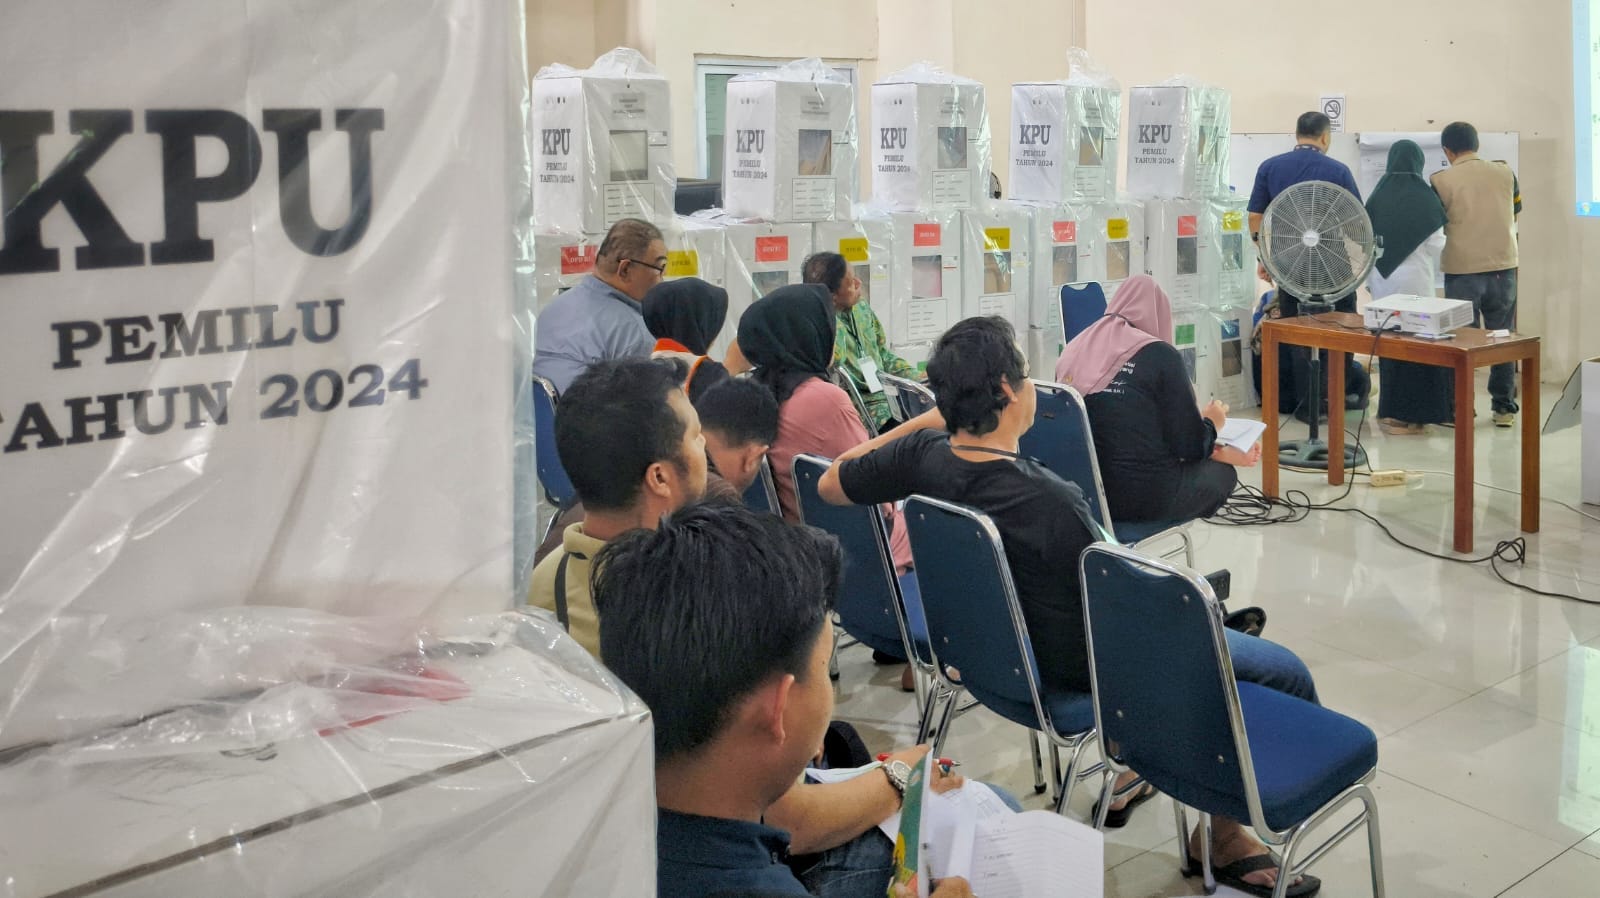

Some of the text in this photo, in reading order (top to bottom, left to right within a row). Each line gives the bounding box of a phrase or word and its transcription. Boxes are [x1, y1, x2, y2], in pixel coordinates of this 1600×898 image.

[541, 128, 571, 155] KPU
[736, 129, 765, 154] KPU
[880, 127, 908, 149] KPU
[1019, 124, 1052, 145] KPU
[1138, 124, 1172, 144] KPU
[1022, 149, 1047, 157] PEMILU
[1134, 156, 1175, 165] TAHUN 2024
[1142, 147, 1167, 155] PEMILU
[545, 162, 568, 171] PEMILU
[878, 164, 896, 173] TAHUN
[1015, 158, 1054, 168] TAHUN 2024
[0, 108, 385, 275] KPU
[50, 298, 346, 370] PEMILU
[0, 358, 430, 454] AHUN 2024
